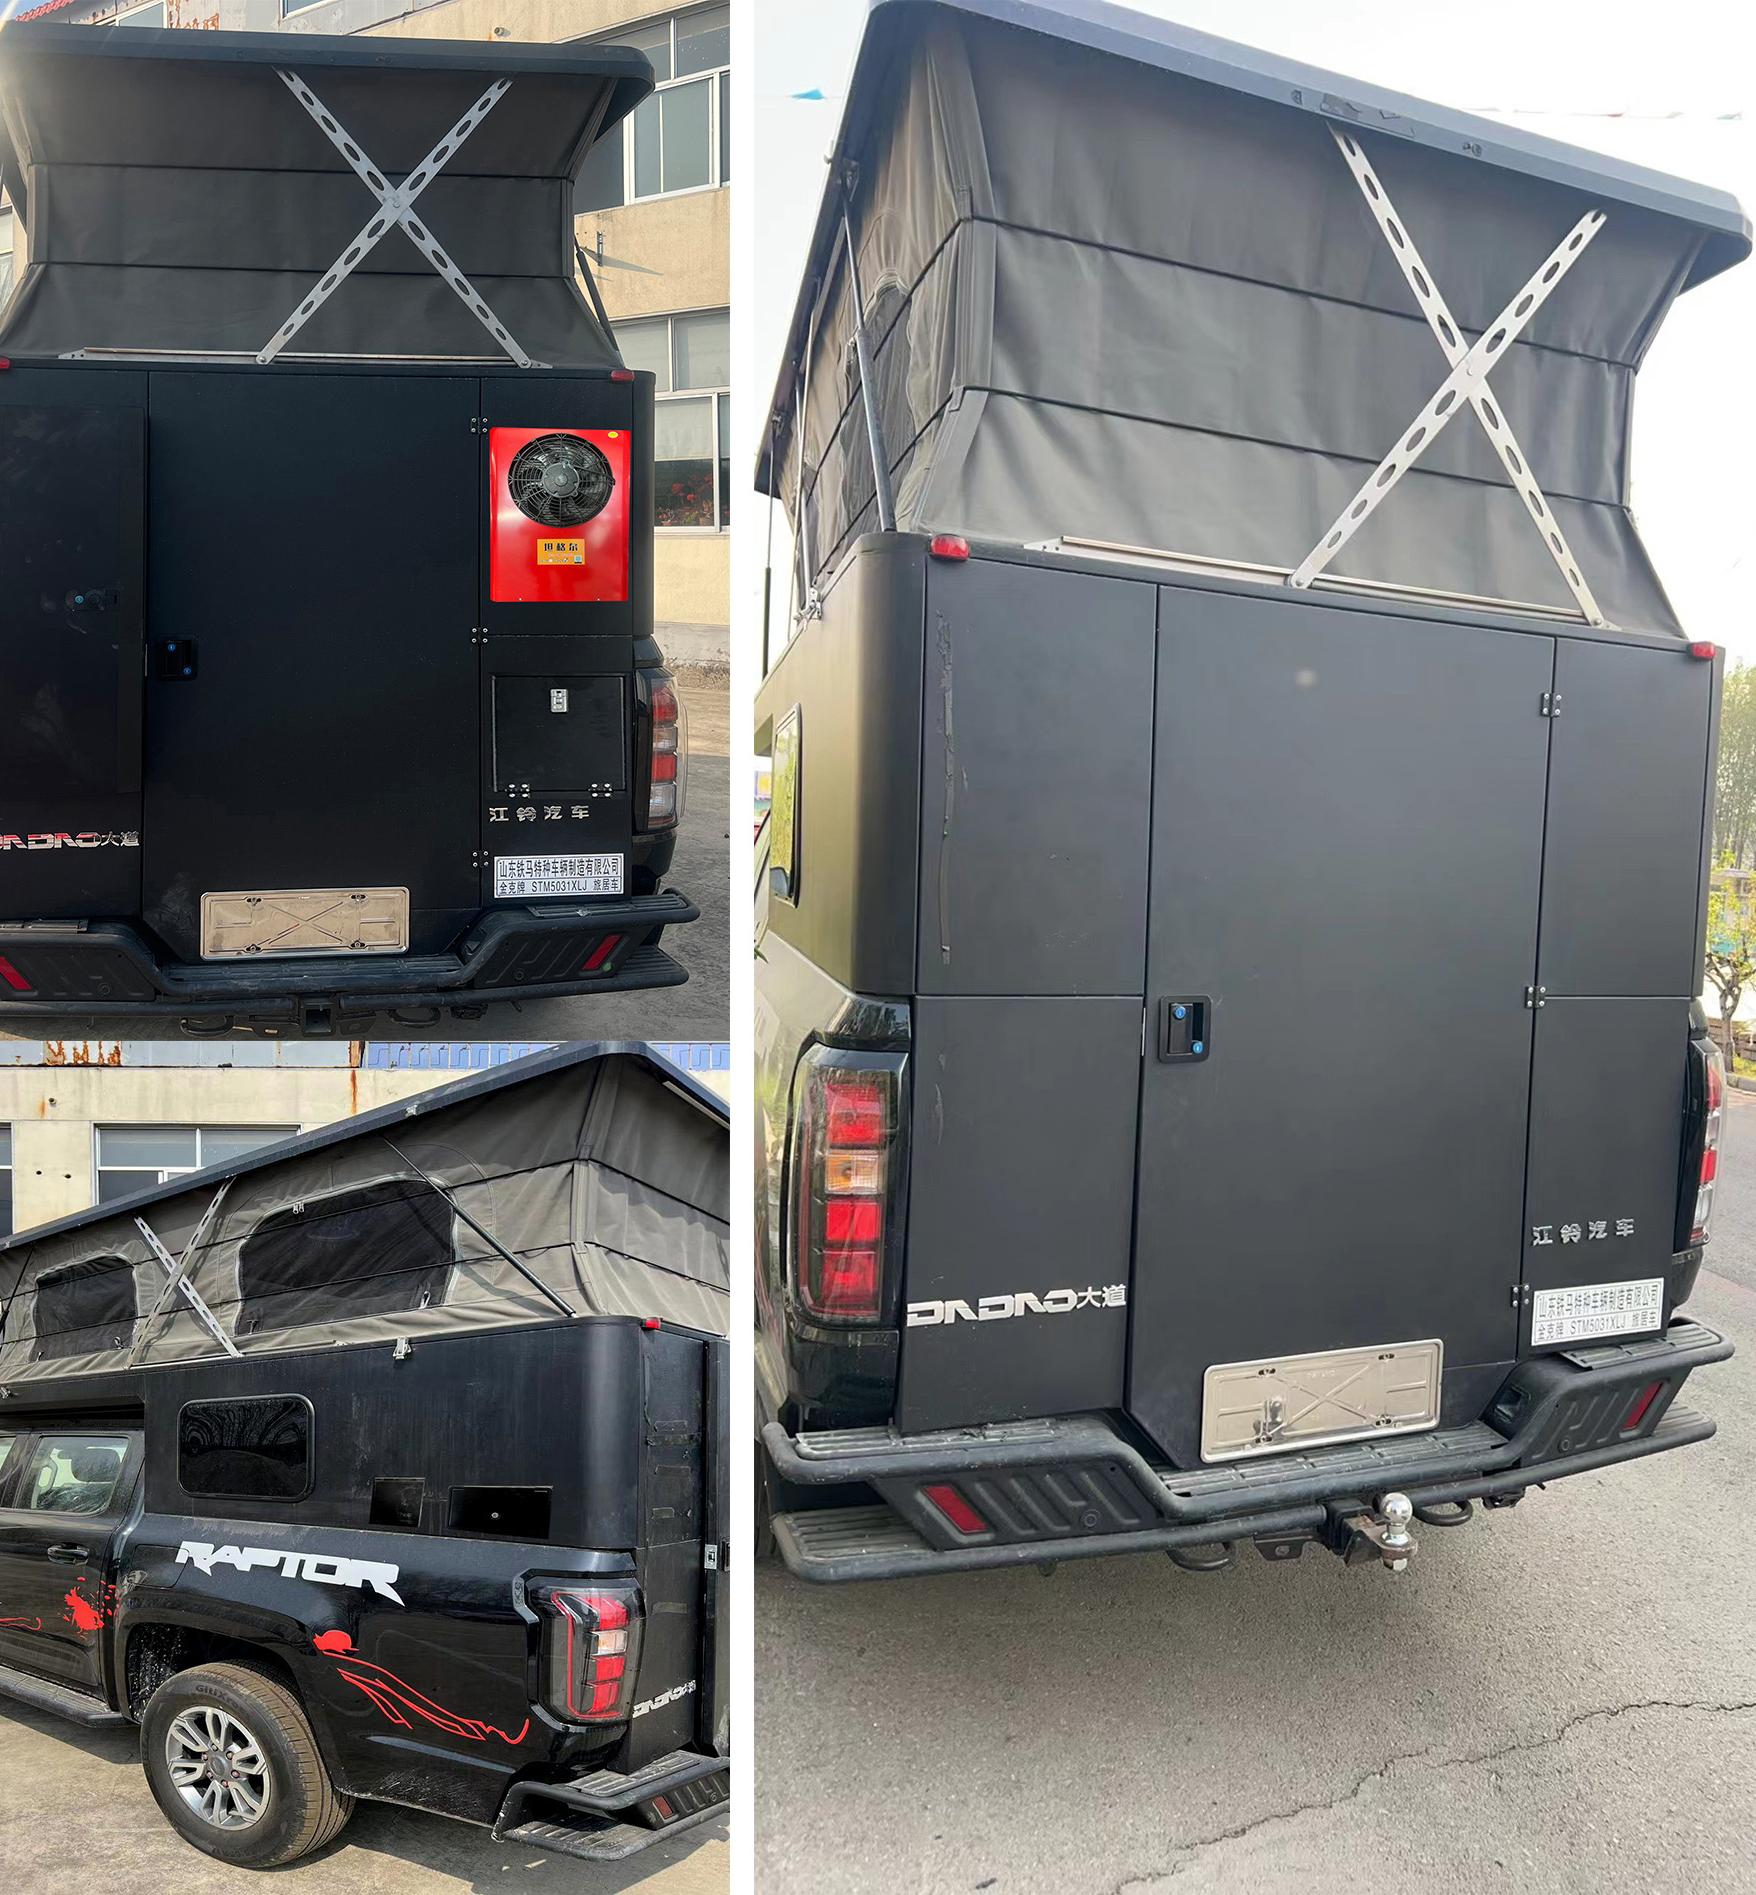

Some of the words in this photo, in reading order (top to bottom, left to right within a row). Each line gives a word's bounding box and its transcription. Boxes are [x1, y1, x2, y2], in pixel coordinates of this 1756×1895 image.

[489, 805, 590, 822] 江铃汽车
[531, 881, 587, 892] STM5031XLJ
[1532, 1219, 1635, 1247] 江铃汽车
[1570, 1316, 1626, 1335] STM5031XLJ
[175, 1541, 405, 1607] RAPTOR
